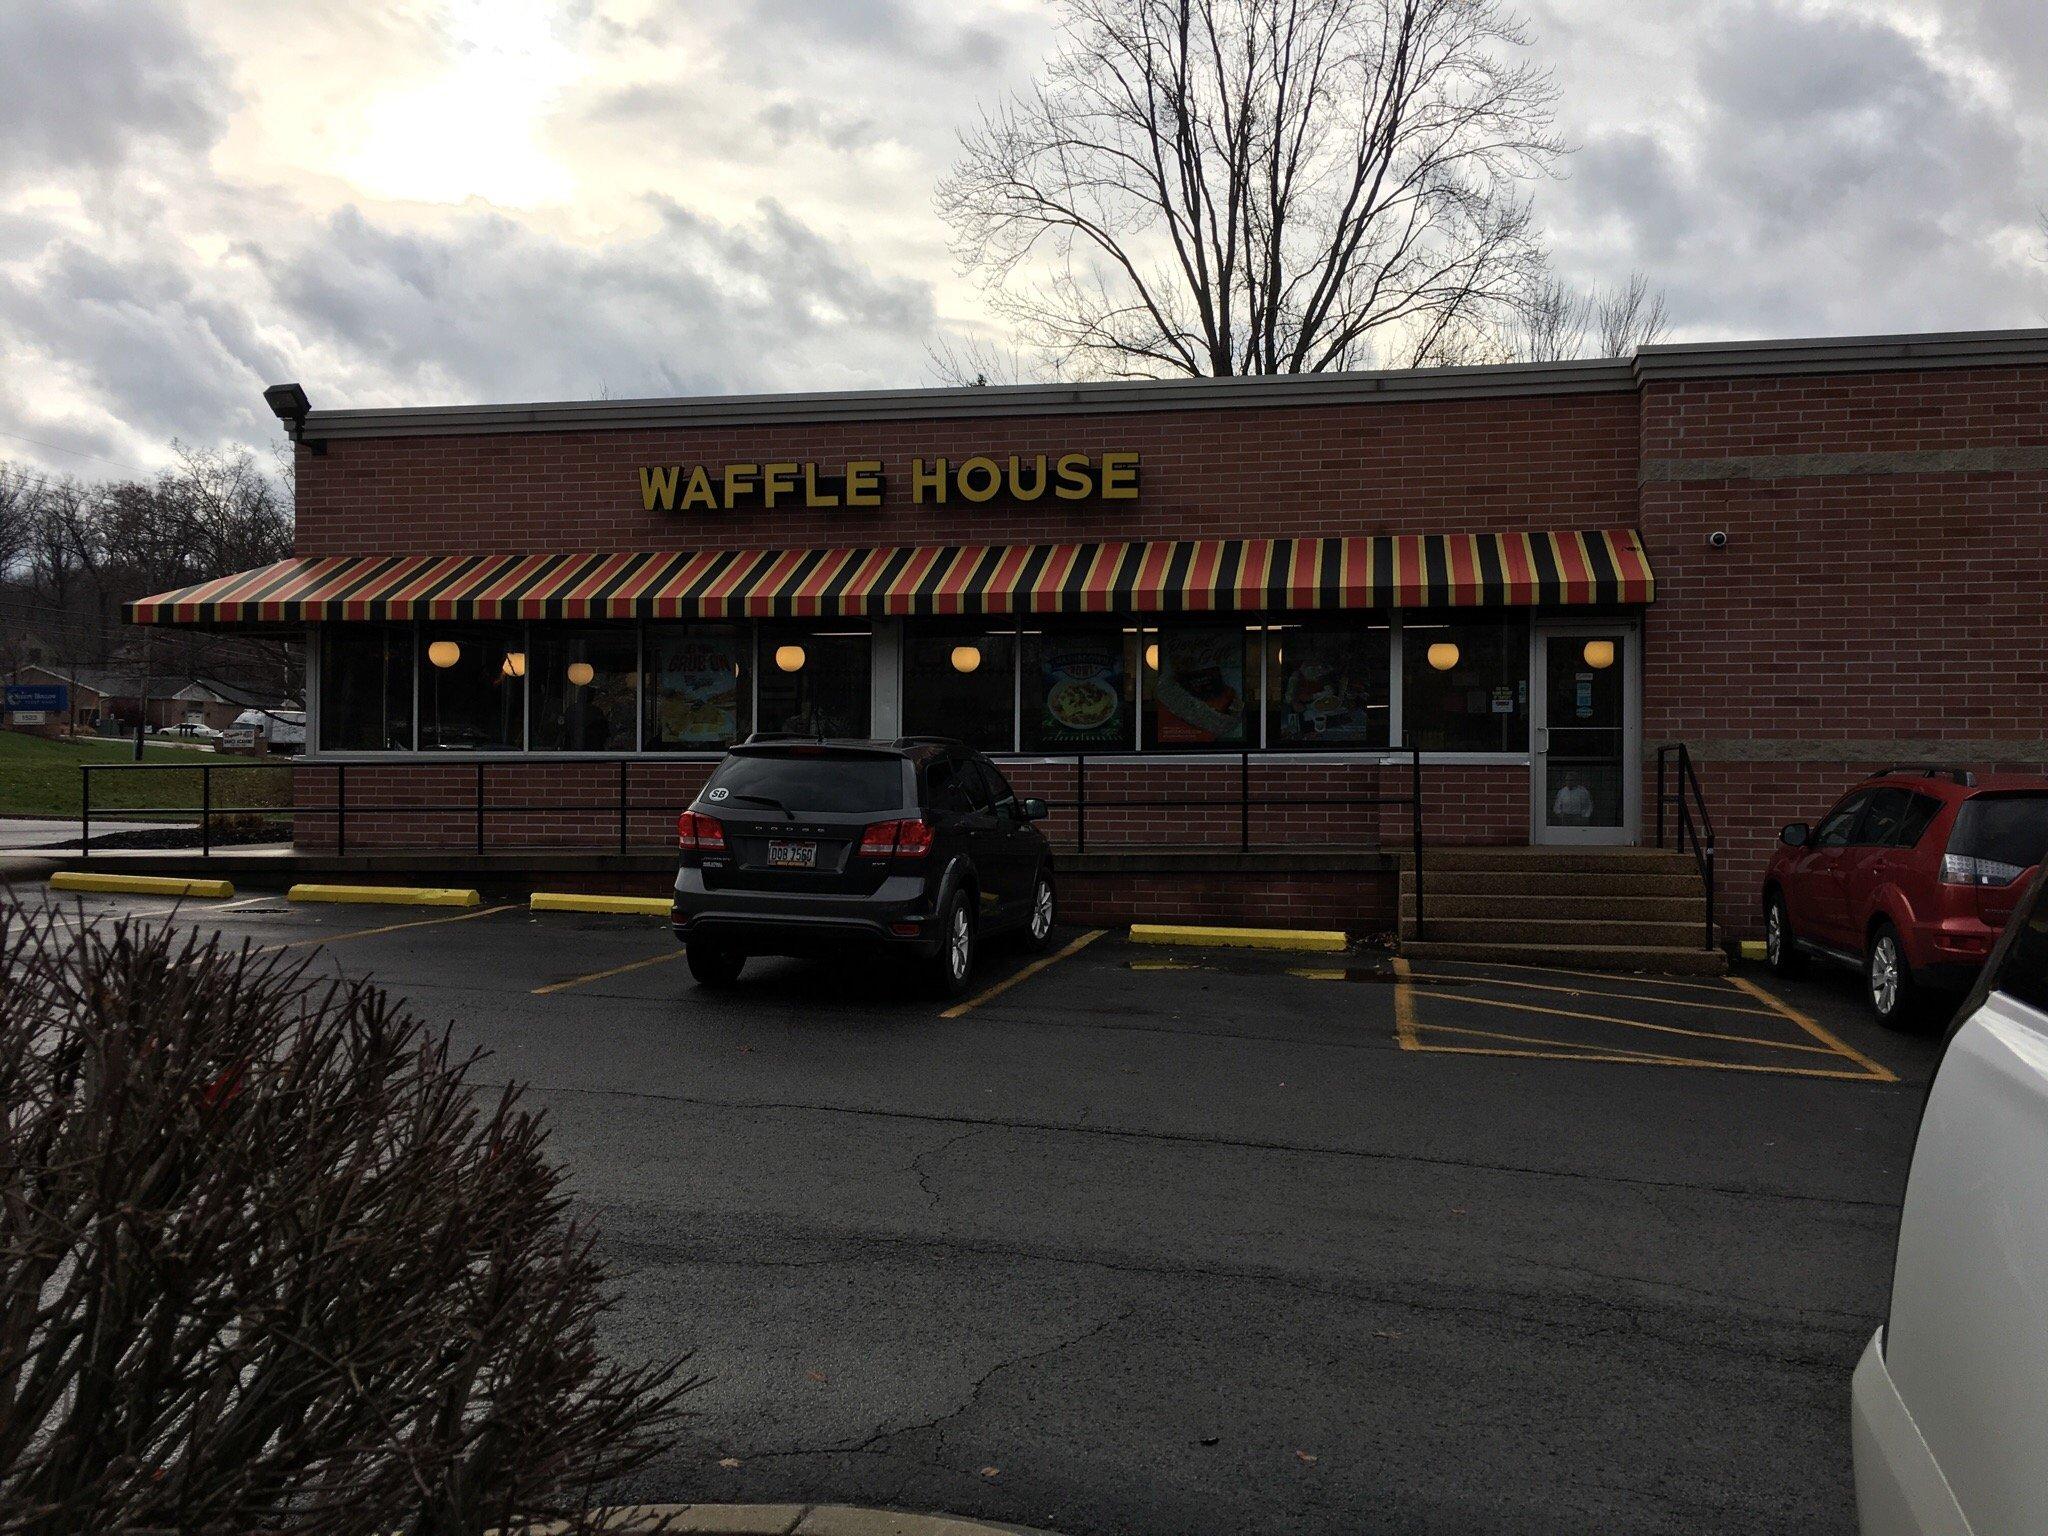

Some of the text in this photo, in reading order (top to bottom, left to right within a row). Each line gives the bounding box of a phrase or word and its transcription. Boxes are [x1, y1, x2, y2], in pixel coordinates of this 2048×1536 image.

[638, 451, 1140, 511] WAFFLE HOUSE
[711, 788, 727, 799] SB
